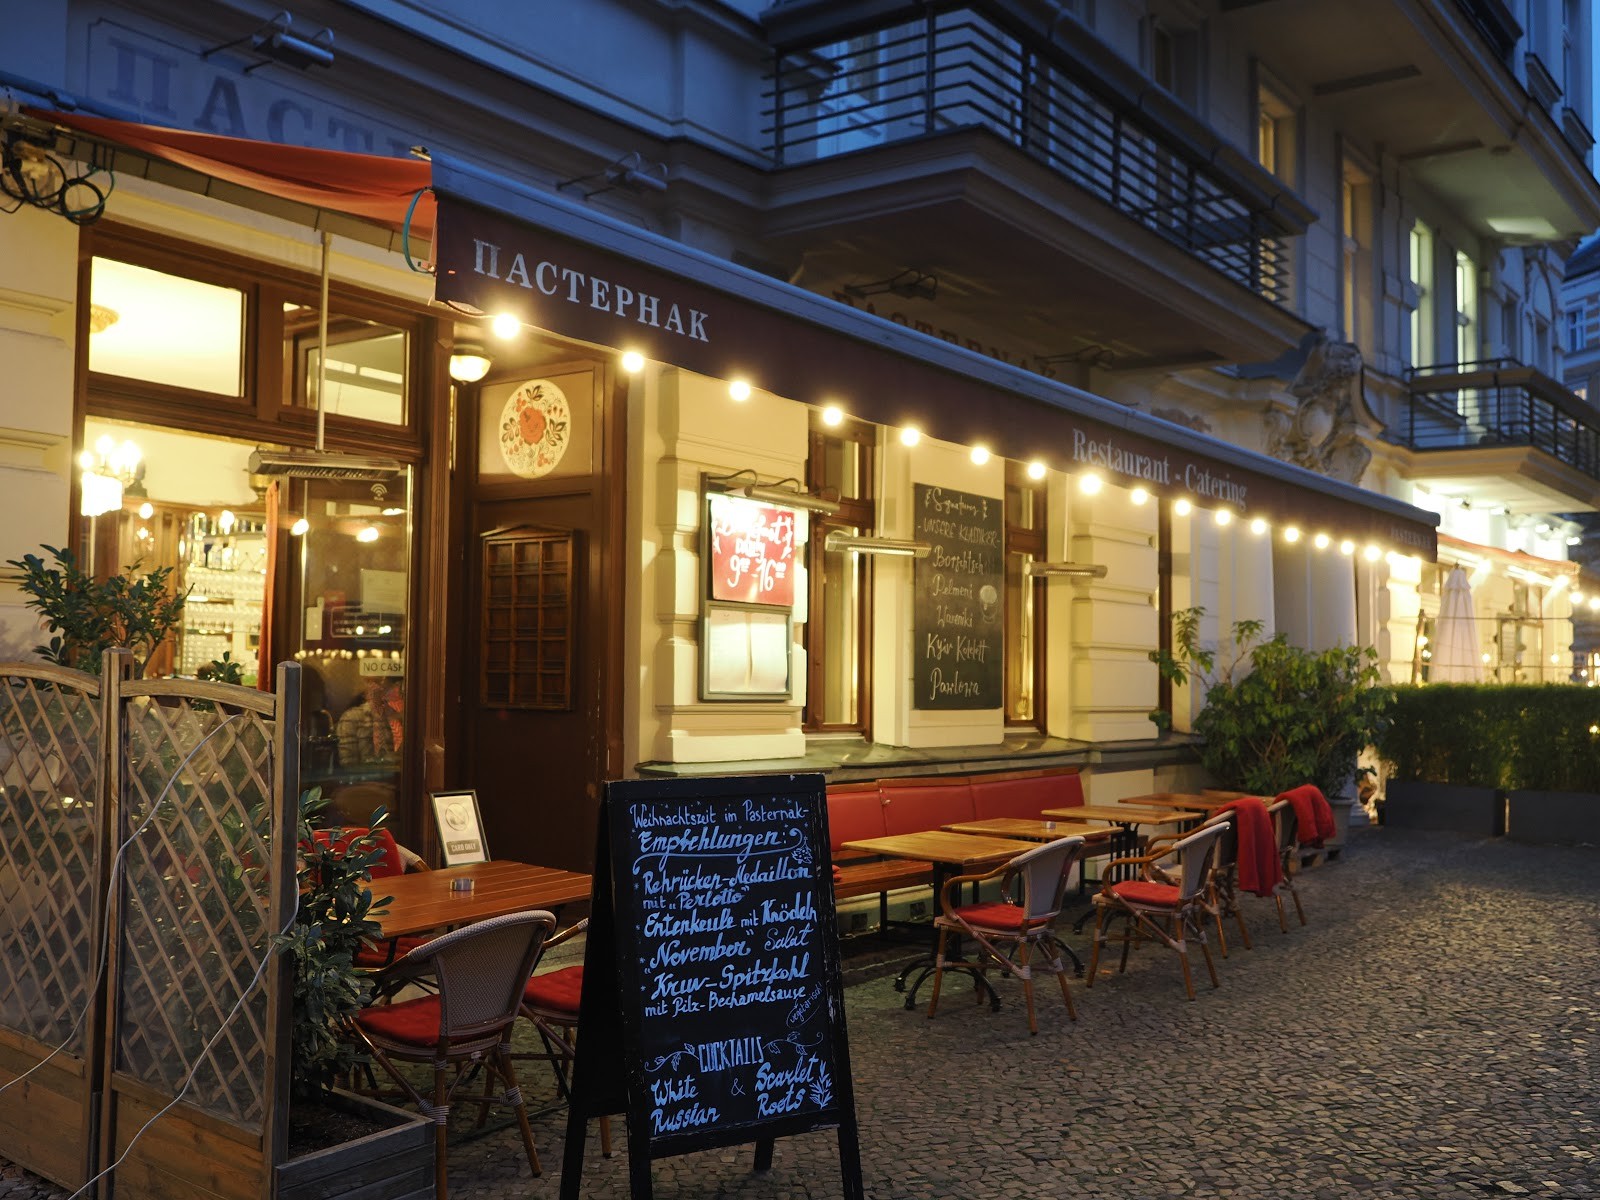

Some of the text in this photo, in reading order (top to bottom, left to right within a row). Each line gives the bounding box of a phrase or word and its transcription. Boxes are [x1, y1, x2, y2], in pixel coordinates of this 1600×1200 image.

[473, 237, 710, 343] ПАСТЕРНАК
[1072, 428, 1170, 486] Restaurant
[1185, 463, 1248, 512] Catering
[924, 517, 957, 539] UNSERE
[932, 573, 973, 600] Pelmeni
[363, 662, 378, 672] NO
[630, 803, 717, 828] Weihnachtszeit
[724, 808, 738, 823] im
[643, 896, 667, 910] mit
[644, 891, 818, 938] Entenkeule mit Knödeln
[764, 922, 814, 951] Salat
[645, 1002, 668, 1017] mit
[698, 1036, 765, 1073] COCKTAILS
[730, 1078, 746, 1096] &
[754, 1051, 819, 1092] Scarlet
[650, 1074, 699, 1107] White
[757, 1084, 806, 1118] Roots
[650, 1102, 720, 1135] Russian
